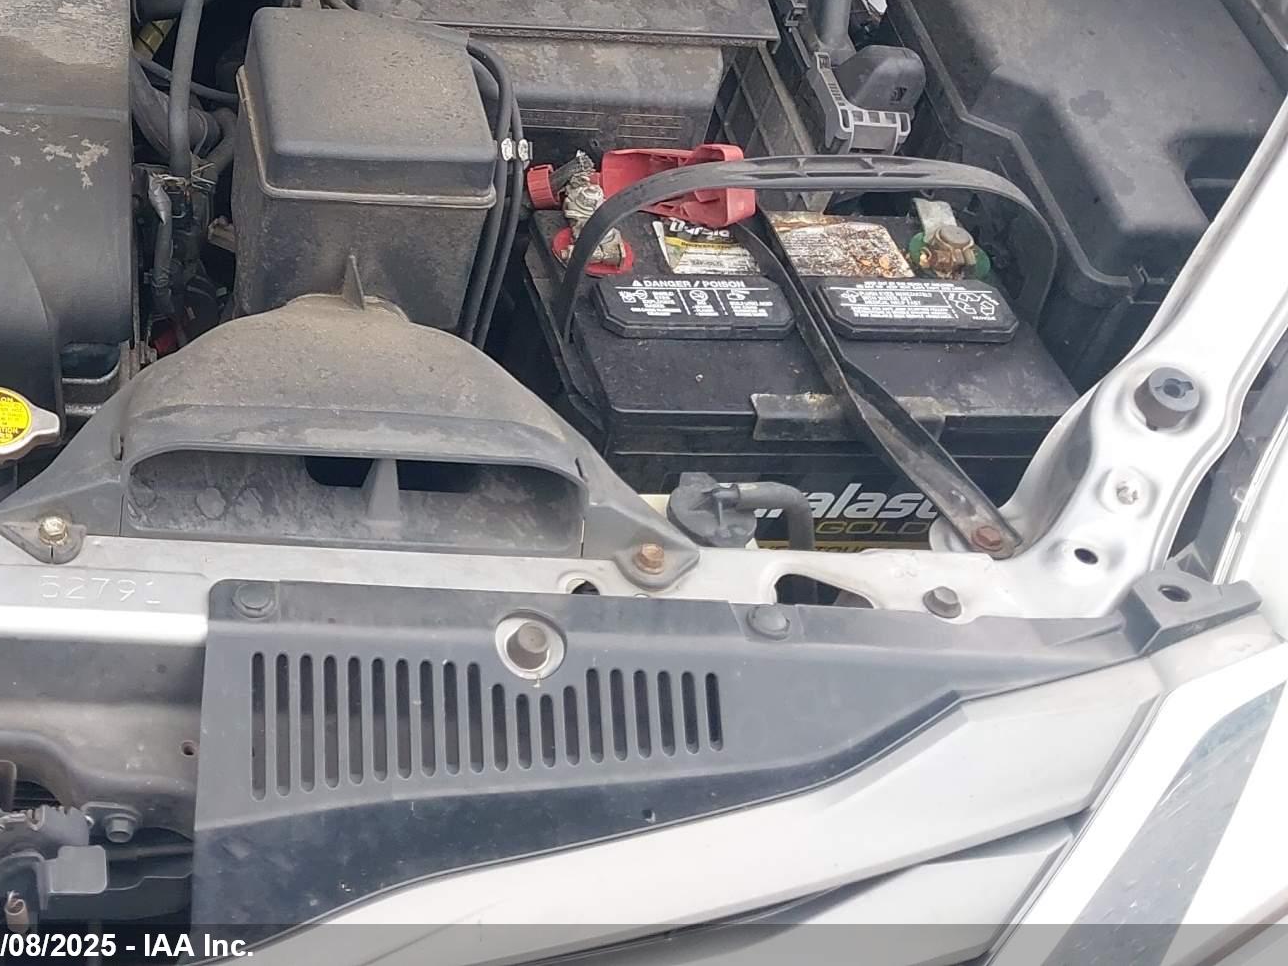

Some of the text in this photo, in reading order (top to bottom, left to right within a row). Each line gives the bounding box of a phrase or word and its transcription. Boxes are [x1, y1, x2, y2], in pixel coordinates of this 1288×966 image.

[643, 280, 746, 288] DANGER / POISON
[815, 521, 930, 535] GOLD
